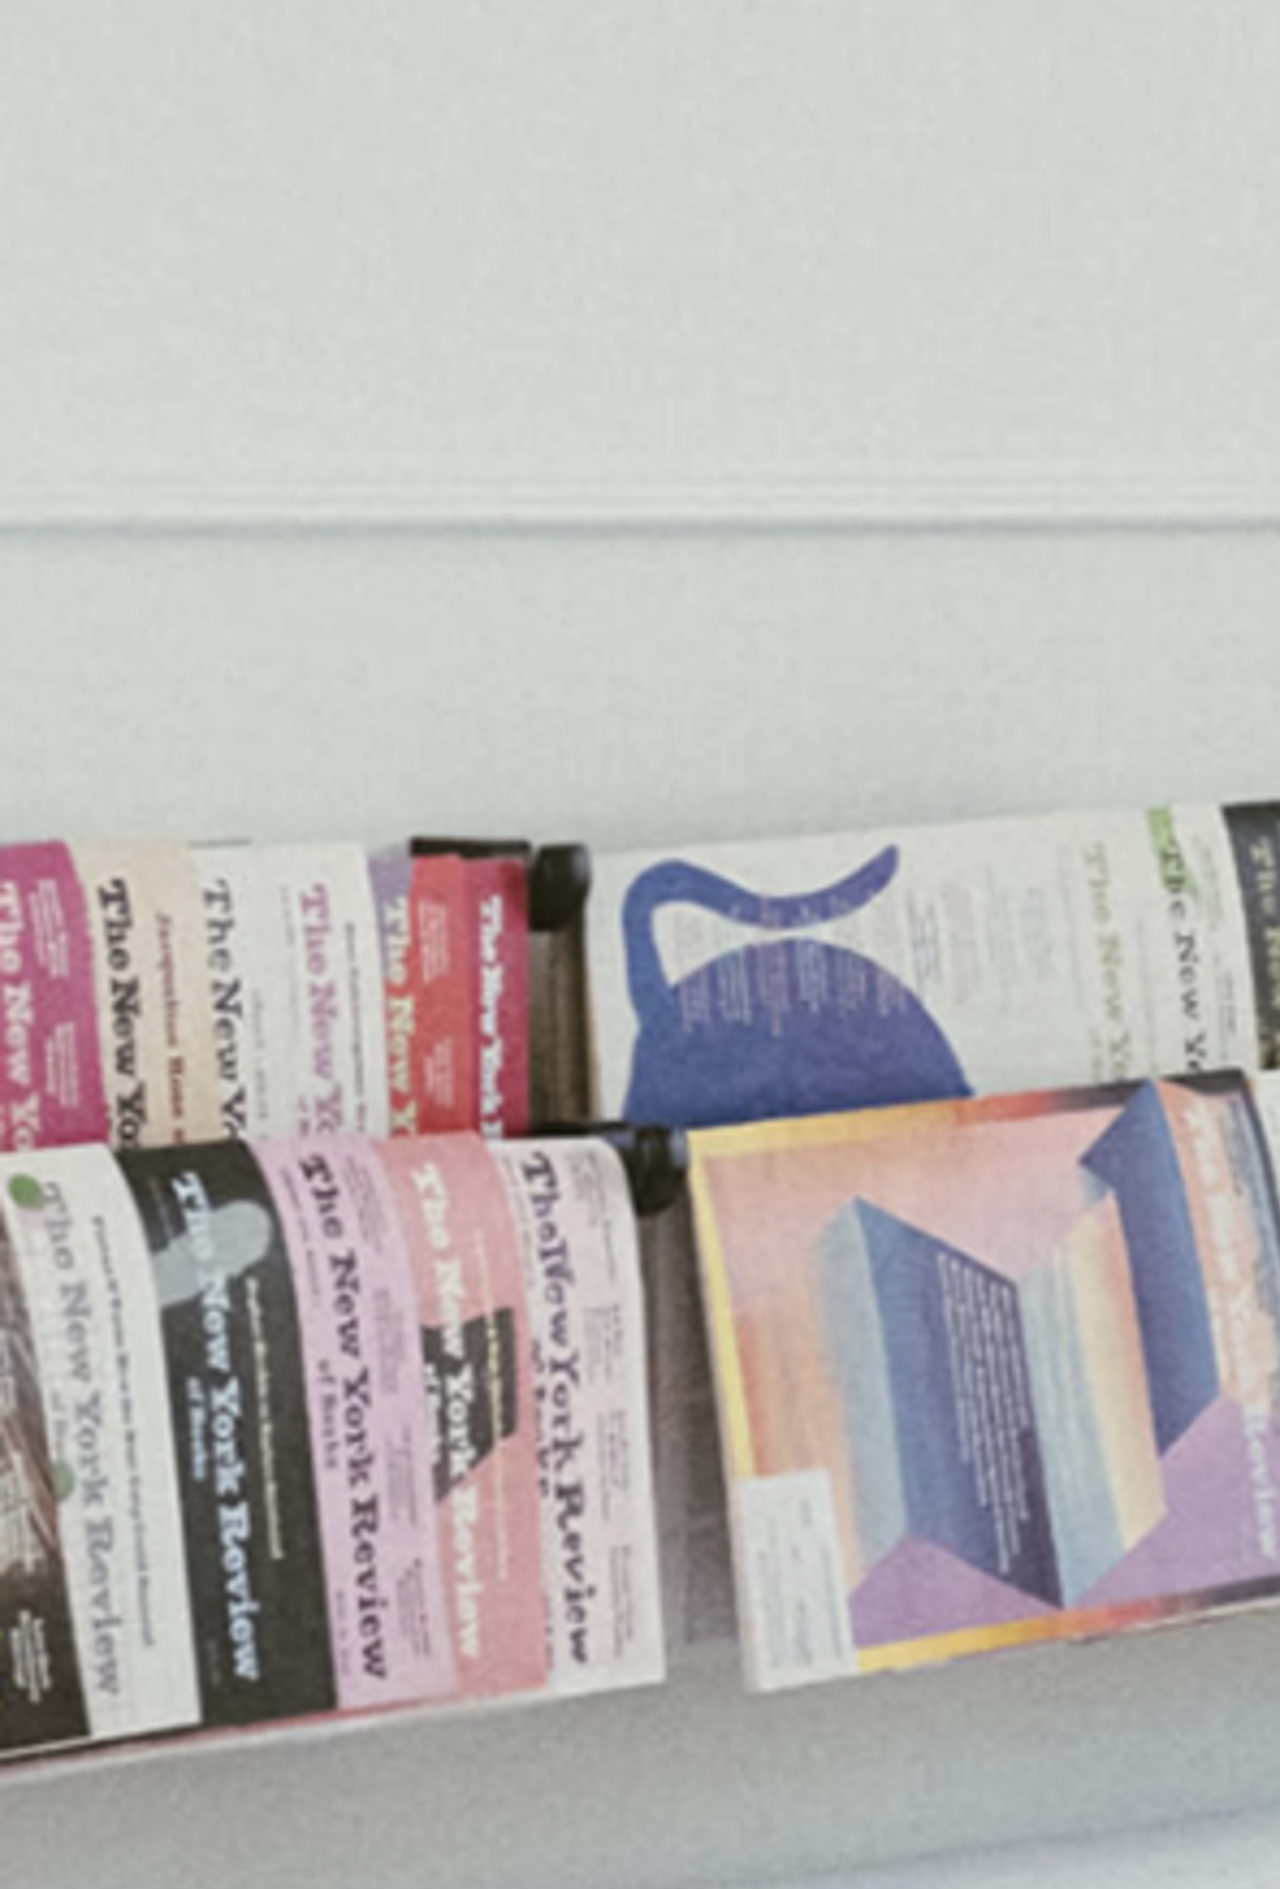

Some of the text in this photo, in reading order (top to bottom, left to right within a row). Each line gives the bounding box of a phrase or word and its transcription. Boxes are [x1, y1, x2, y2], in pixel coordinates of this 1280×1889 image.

[96, 877, 131, 971] The
[1251, 837, 1275, 914] The
[0, 882, 28, 971] The
[201, 877, 238, 974] The
[297, 885, 333, 974] The
[383, 896, 413, 985] The
[478, 895, 502, 962] The
[1085, 843, 1111, 923] The
[1099, 936, 1123, 1020] New
[1157, 837, 1188, 921] The
[1175, 931, 1203, 1022] New
[2, 980, 37, 1085] New
[109, 978, 142, 1079] New
[209, 979, 245, 1082] New
[306, 981, 340, 1079] New
[387, 996, 416, 1094] New
[479, 966, 502, 1035] New
[63, 1283, 96, 1380] New
[316, 1361, 336, 1389] of
[172, 1172, 263, 1681] The New York Review
[186, 1377, 206, 1407] of
[298, 1155, 389, 1681] The New York Review
[410, 1164, 485, 1659] The New York Review
[548, 1353, 589, 1469] York
[72, 1391, 108, 1506] York
[83, 1519, 126, 1697] Review
[553, 1484, 597, 1664] Review
